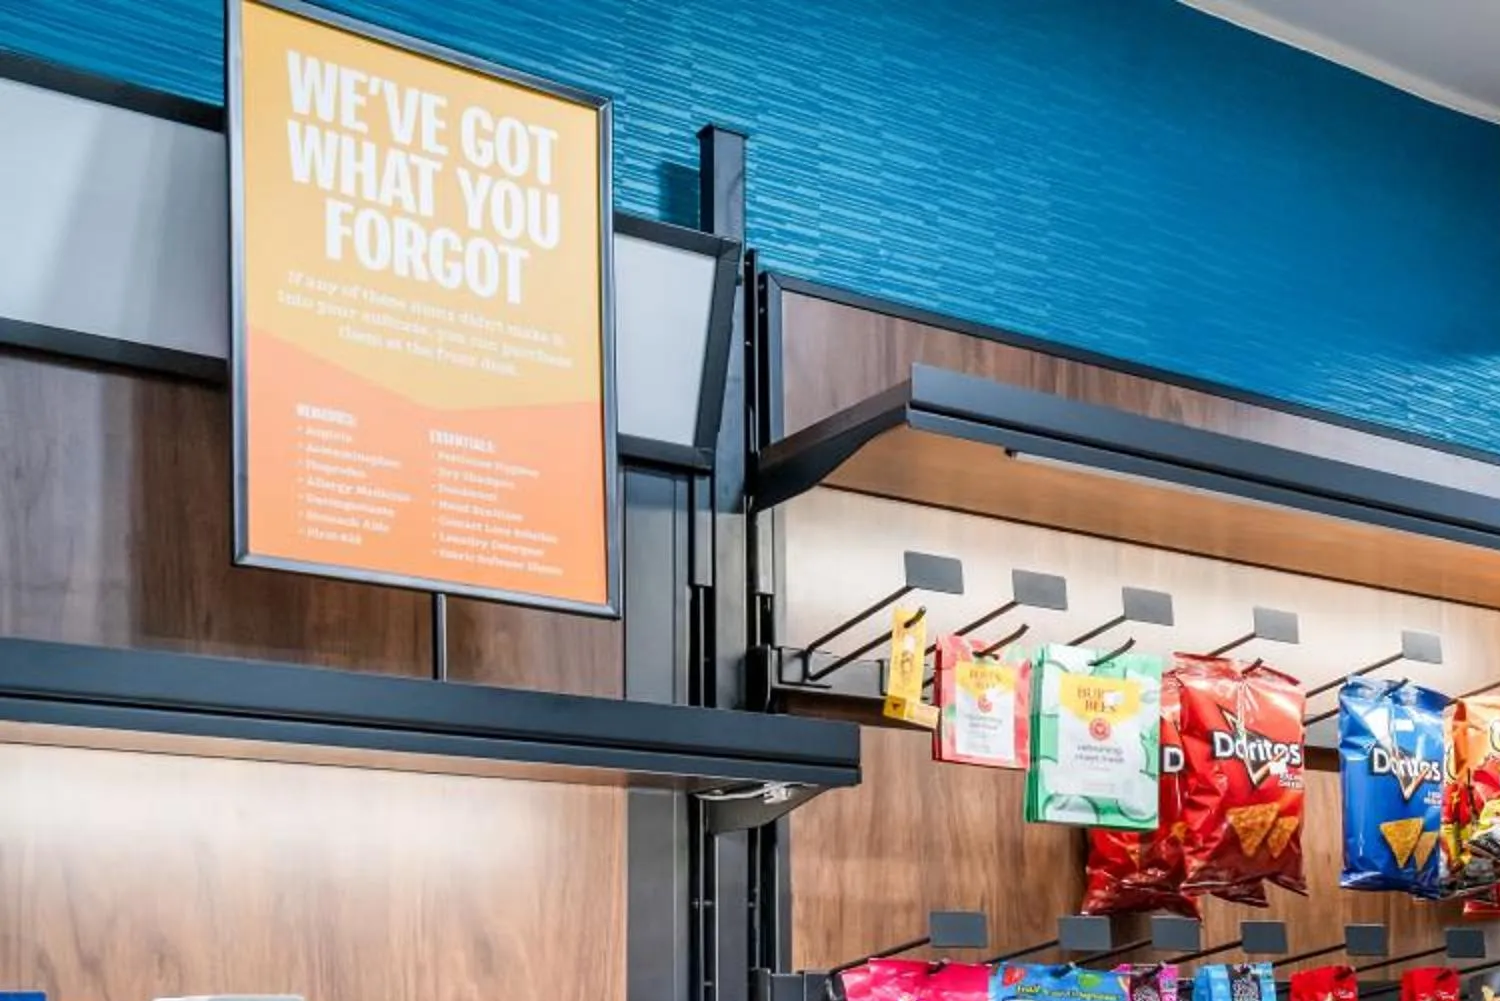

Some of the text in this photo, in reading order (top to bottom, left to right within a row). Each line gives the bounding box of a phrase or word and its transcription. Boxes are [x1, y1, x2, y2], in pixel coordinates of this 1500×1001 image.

[287, 50, 558, 185] WE'VE GOT
[287, 119, 561, 249] WHAT YOU
[324, 198, 529, 304] FORGOT
[1213, 731, 1301, 765] Doritos
[1373, 748, 1440, 781] Doritos
